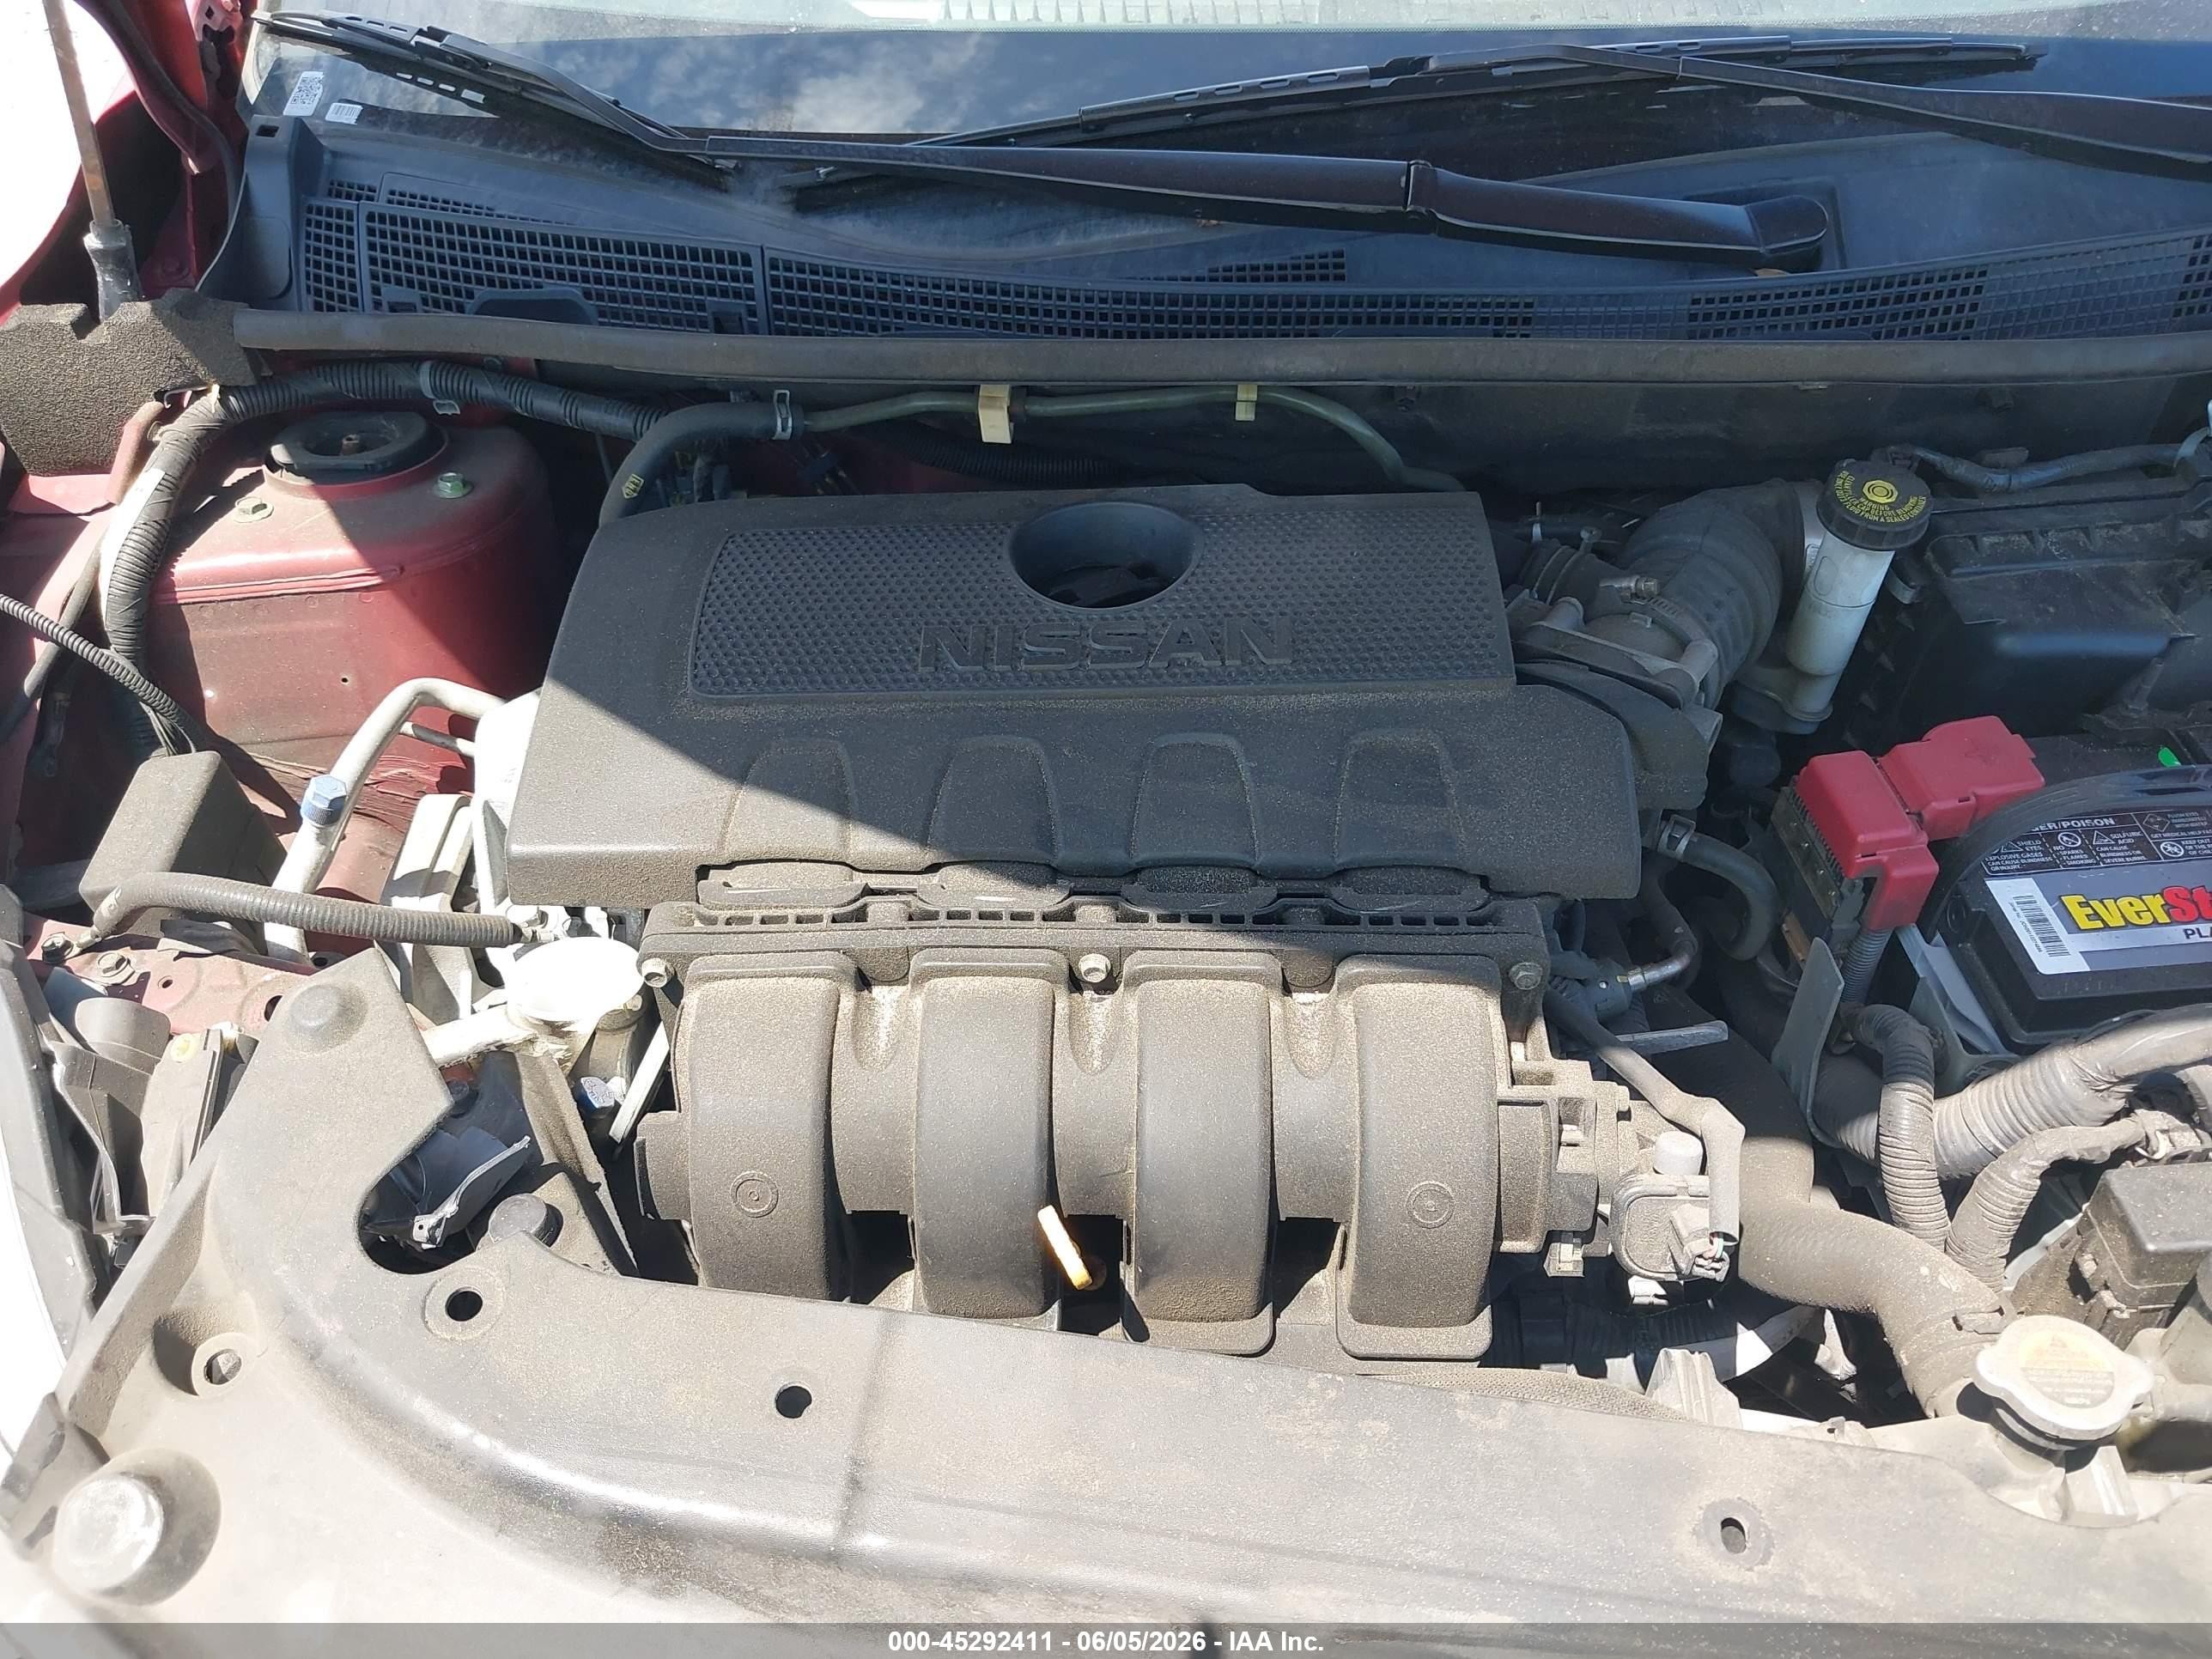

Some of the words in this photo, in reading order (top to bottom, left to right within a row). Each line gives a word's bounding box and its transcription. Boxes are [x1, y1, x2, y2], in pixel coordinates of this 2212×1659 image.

[1856, 502, 1870, 513] CAP
[1870, 508, 1897, 517] BEFORE
[919, 617, 1290, 671] NISSAN
